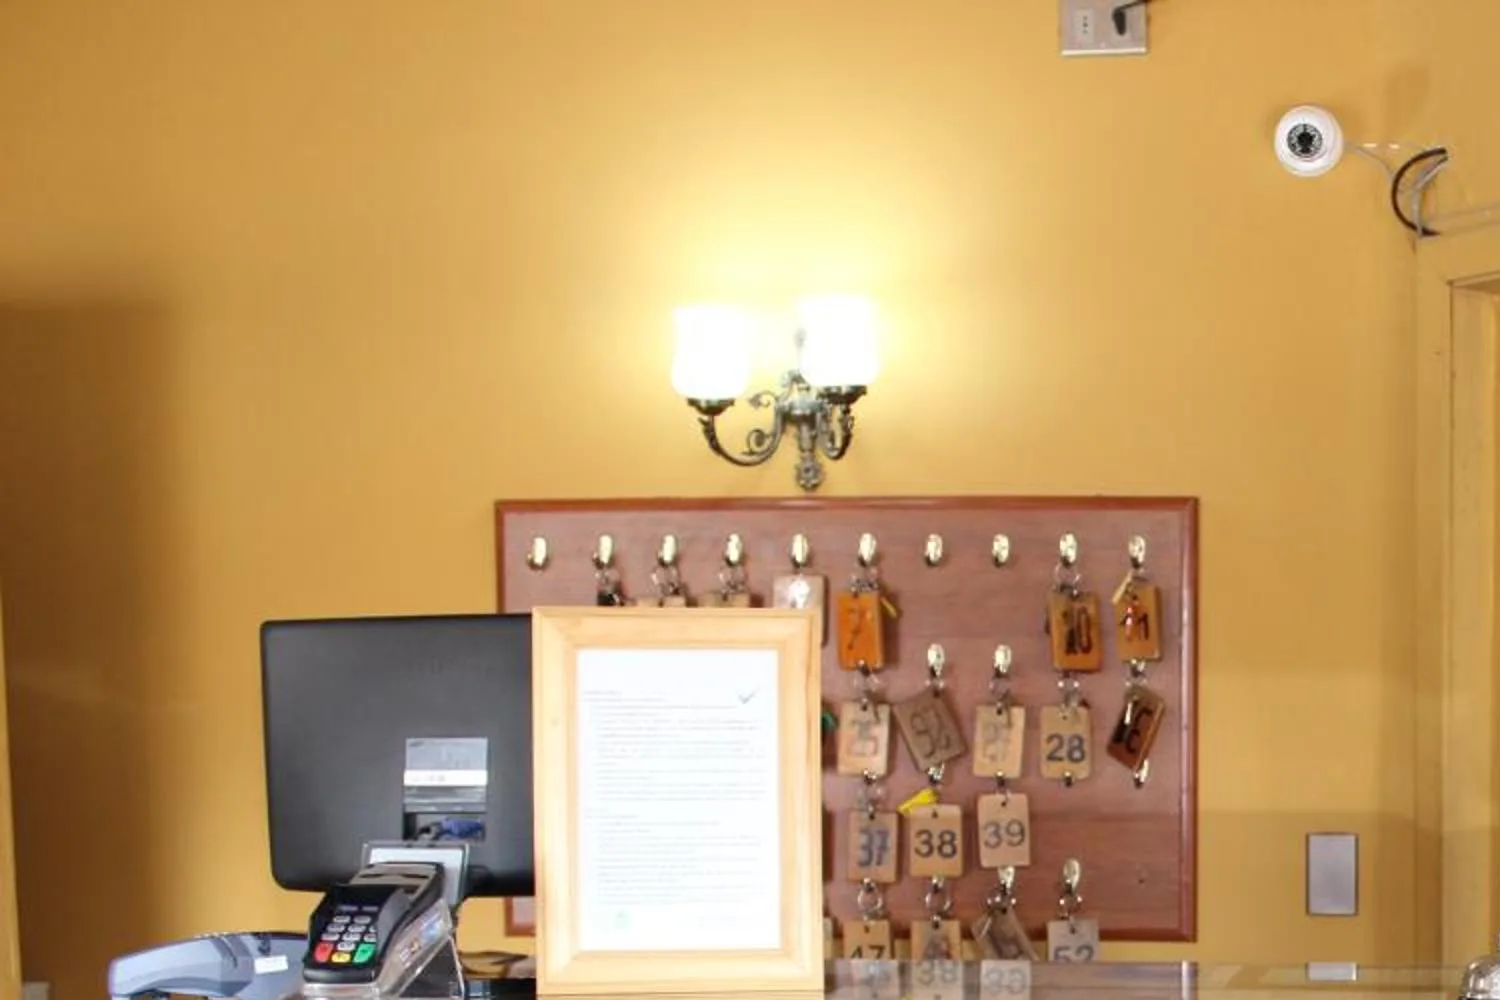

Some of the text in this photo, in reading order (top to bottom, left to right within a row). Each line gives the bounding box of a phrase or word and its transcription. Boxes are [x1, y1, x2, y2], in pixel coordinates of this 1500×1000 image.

[1046, 733, 1086, 763] 28
[858, 828, 890, 867] 37
[914, 829, 958, 859] 38
[982, 820, 1026, 849] 39
